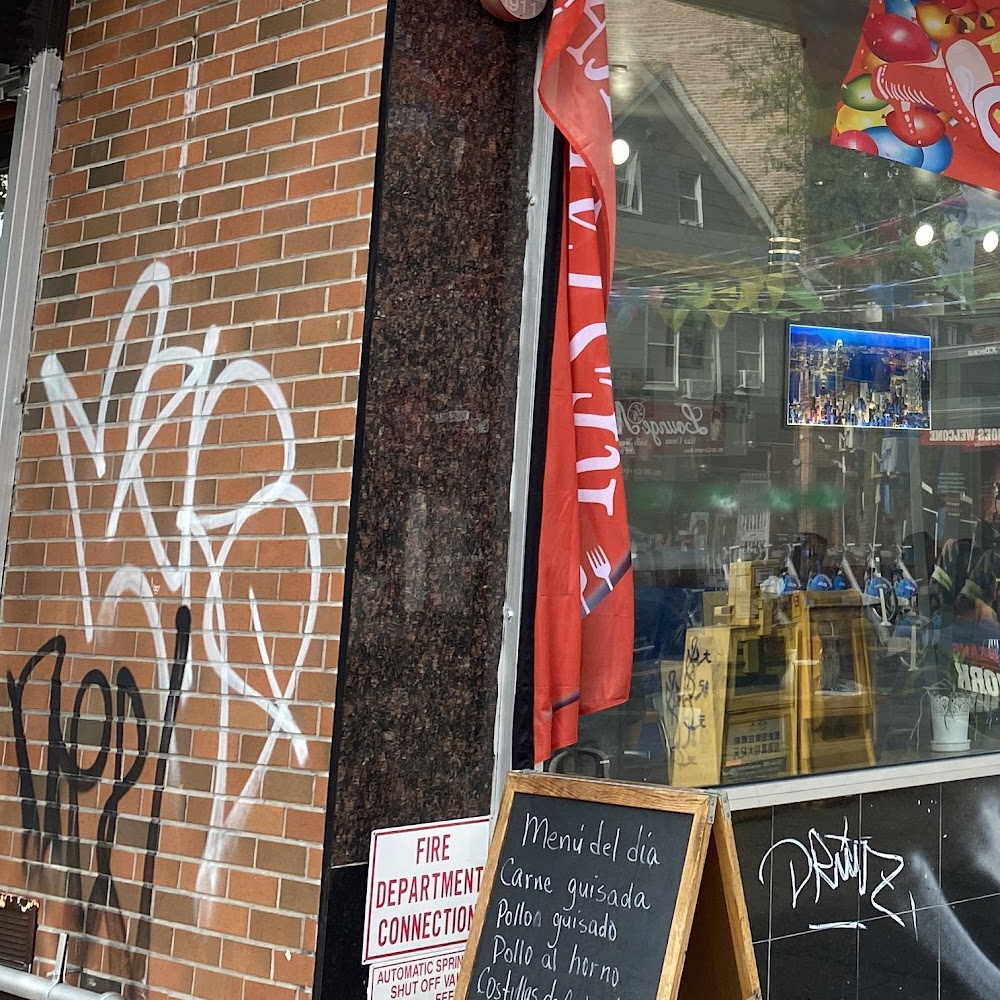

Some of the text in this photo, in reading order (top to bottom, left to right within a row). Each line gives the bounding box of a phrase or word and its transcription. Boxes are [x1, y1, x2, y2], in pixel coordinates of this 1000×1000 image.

[416, 834, 451, 865] FIRE
[521, 812, 661, 867] Menú del día
[375, 866, 484, 909] DEPARTMENT
[500, 857, 651, 911] Carne guisada
[547, 909, 618, 949] guisado
[376, 960, 434, 986] AUTOMATIC
[492, 934, 621, 988] Pollo al horno
[390, 979, 419, 999] SHUT
[420, 975, 442, 993] OFF
[476, 966, 539, 1000] Costillas
